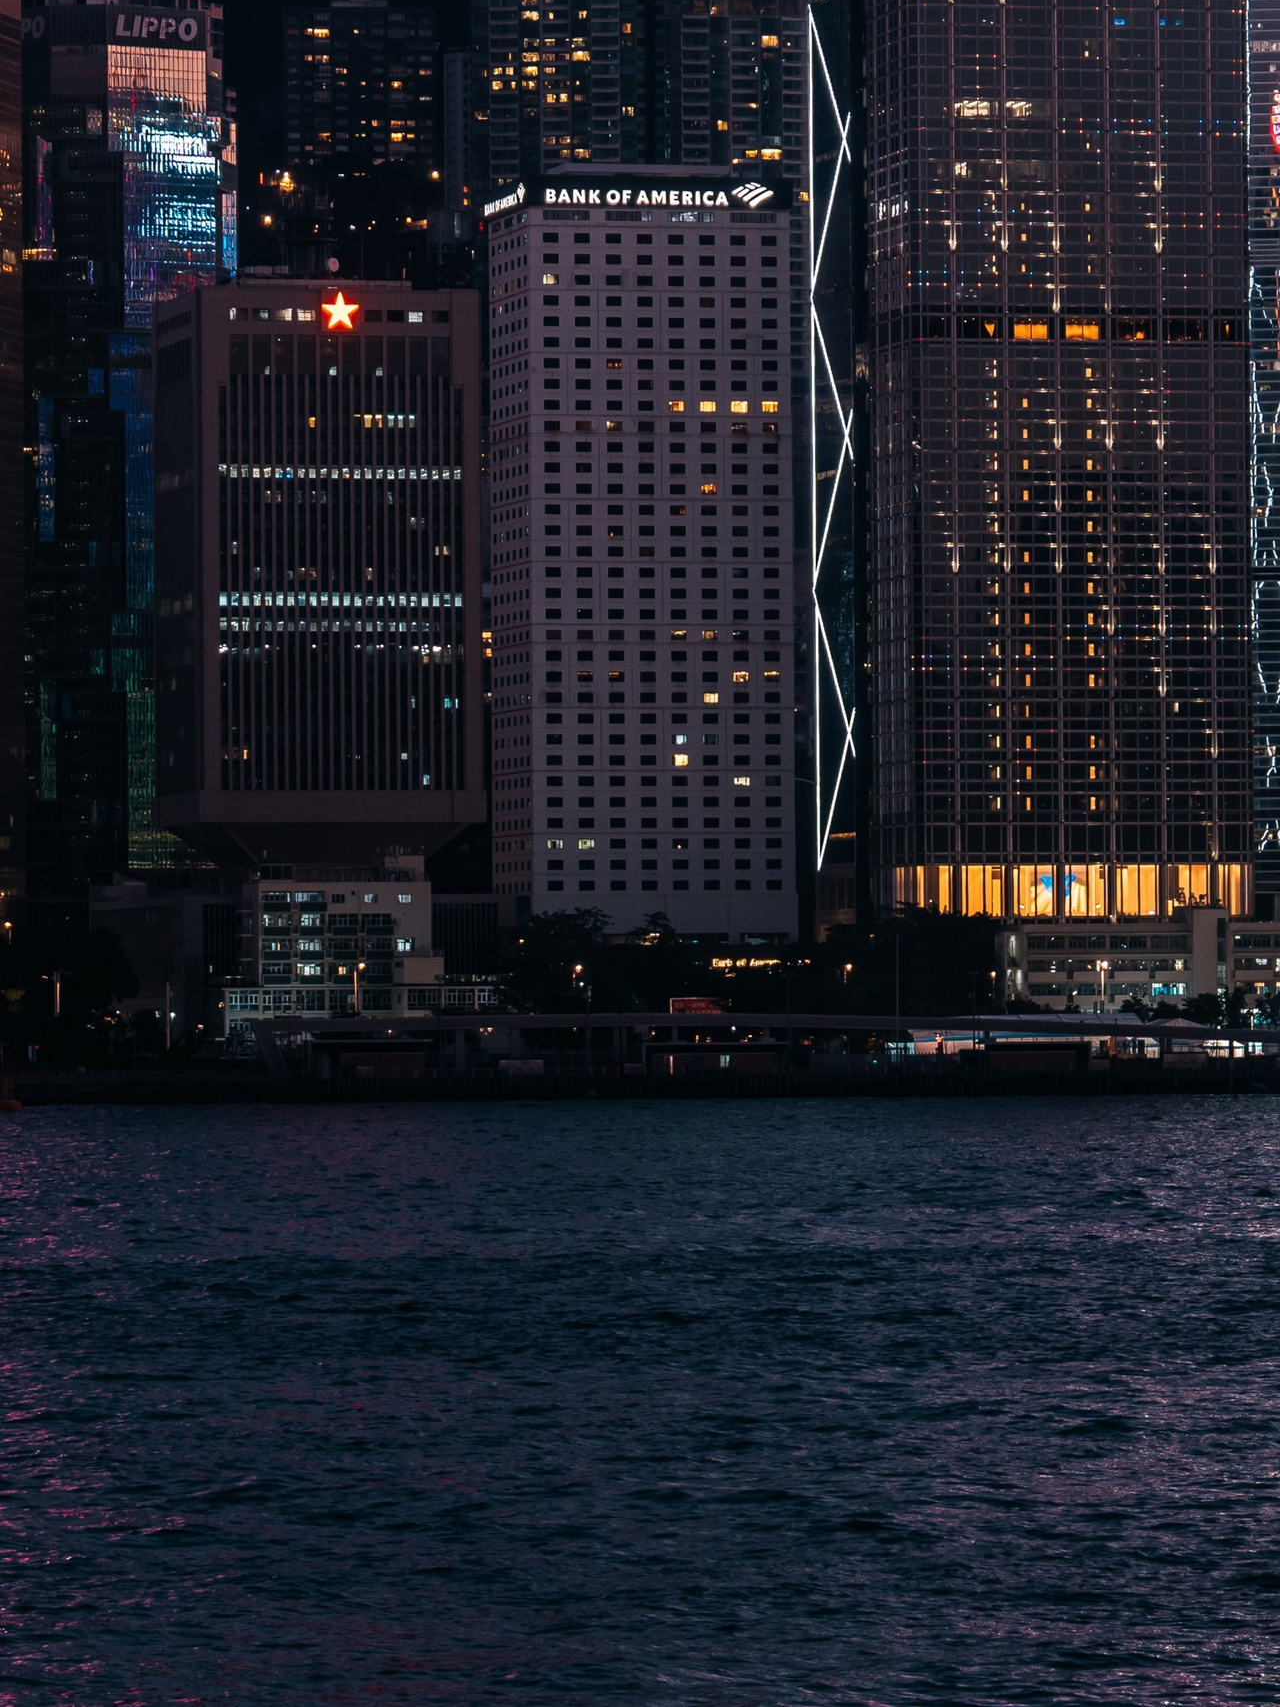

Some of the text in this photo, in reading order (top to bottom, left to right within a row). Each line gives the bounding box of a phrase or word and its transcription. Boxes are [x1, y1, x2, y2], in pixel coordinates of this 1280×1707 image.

[115, 13, 198, 42] LIPPO
[545, 188, 729, 206] BANK OF AMERICA
